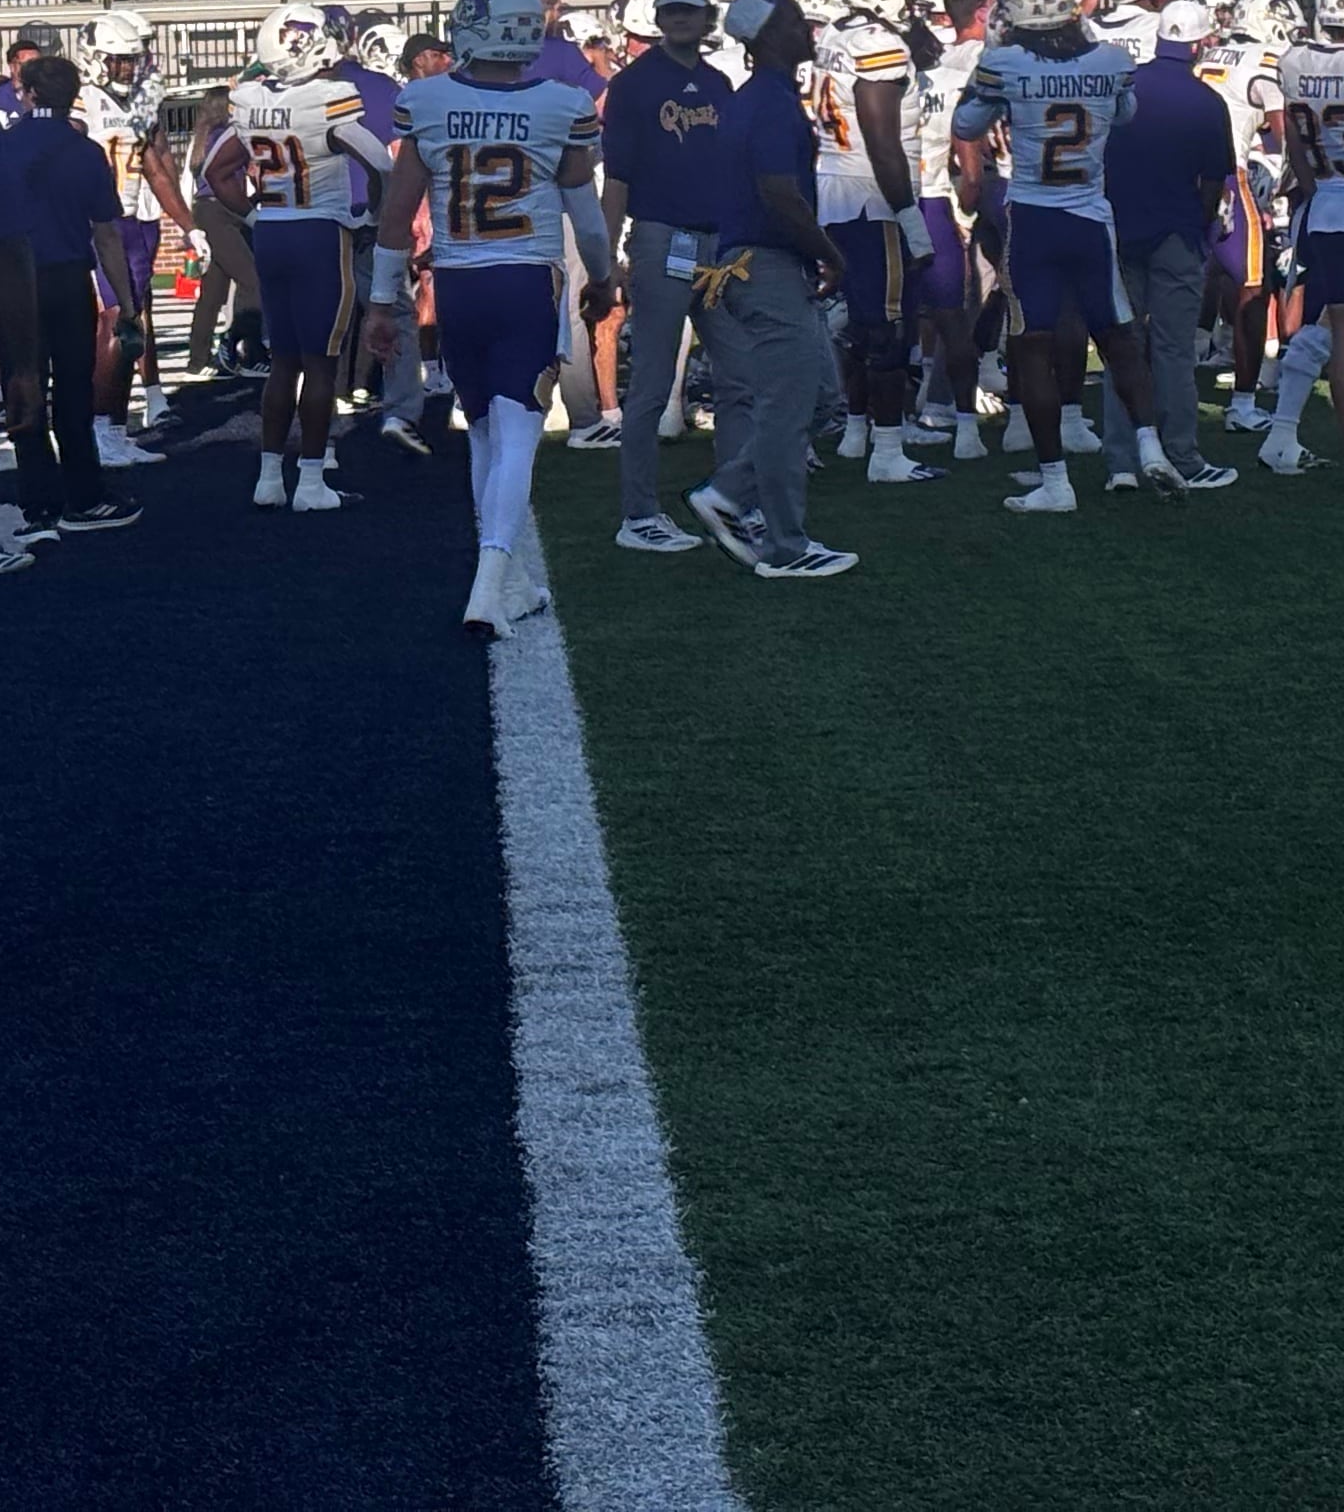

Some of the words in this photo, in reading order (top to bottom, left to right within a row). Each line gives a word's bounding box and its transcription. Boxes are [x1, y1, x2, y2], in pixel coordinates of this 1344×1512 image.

[1298, 74, 1344, 99] SCOTT
[248, 107, 292, 130] ALLEN
[447, 110, 531, 141] GRIFFIS
[1042, 102, 1092, 185] 2
[250, 135, 312, 209] 21
[446, 143, 535, 240] 12
